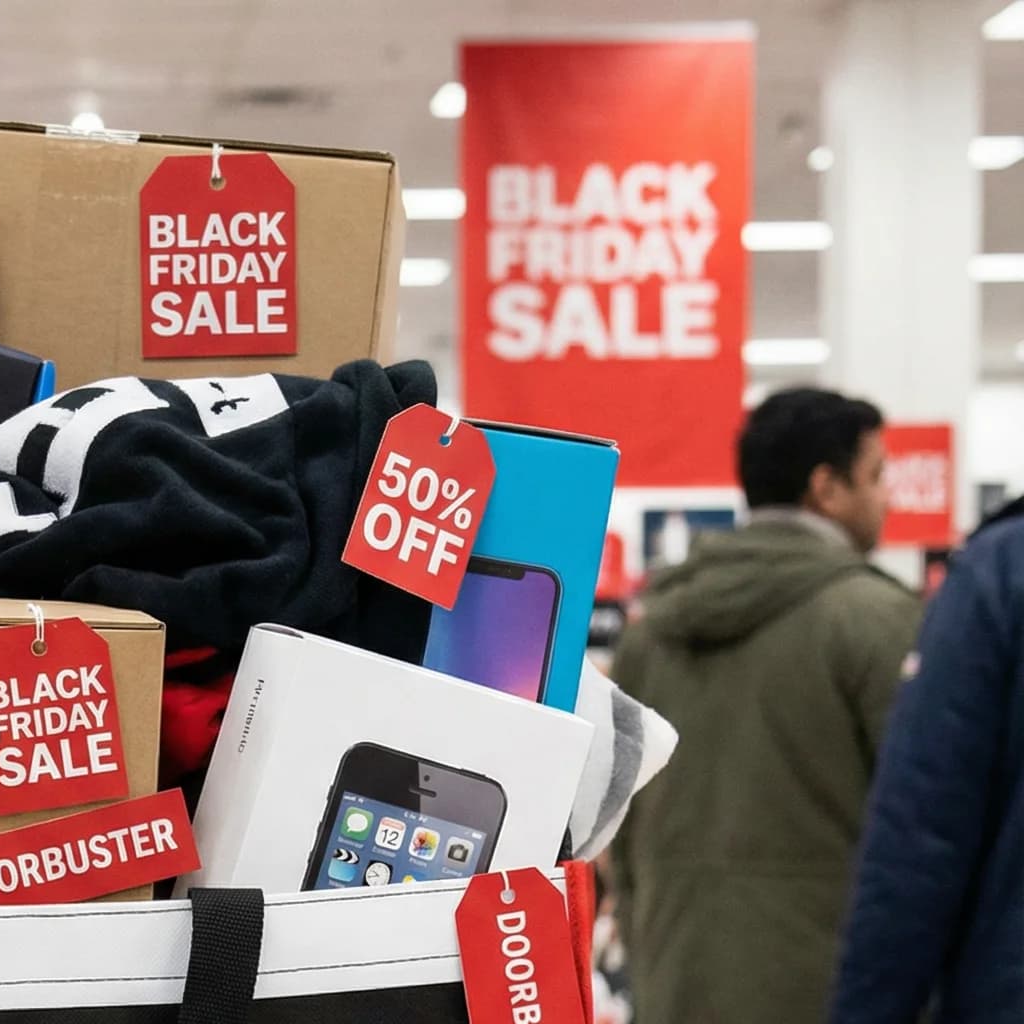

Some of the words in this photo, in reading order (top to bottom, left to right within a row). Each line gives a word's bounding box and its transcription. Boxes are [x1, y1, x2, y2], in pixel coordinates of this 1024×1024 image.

[488, 162, 717, 224] BLACK
[150, 212, 285, 248] BLACK
[489, 222, 717, 283] FRIDAY
[150, 252, 286, 284] FRIDAY
[152, 290, 286, 335] SALE
[489, 284, 719, 360] SALE
[379, 452, 475, 529] 50%
[364, 504, 464, 574] OFF
[381, 829, 400, 847] 12
